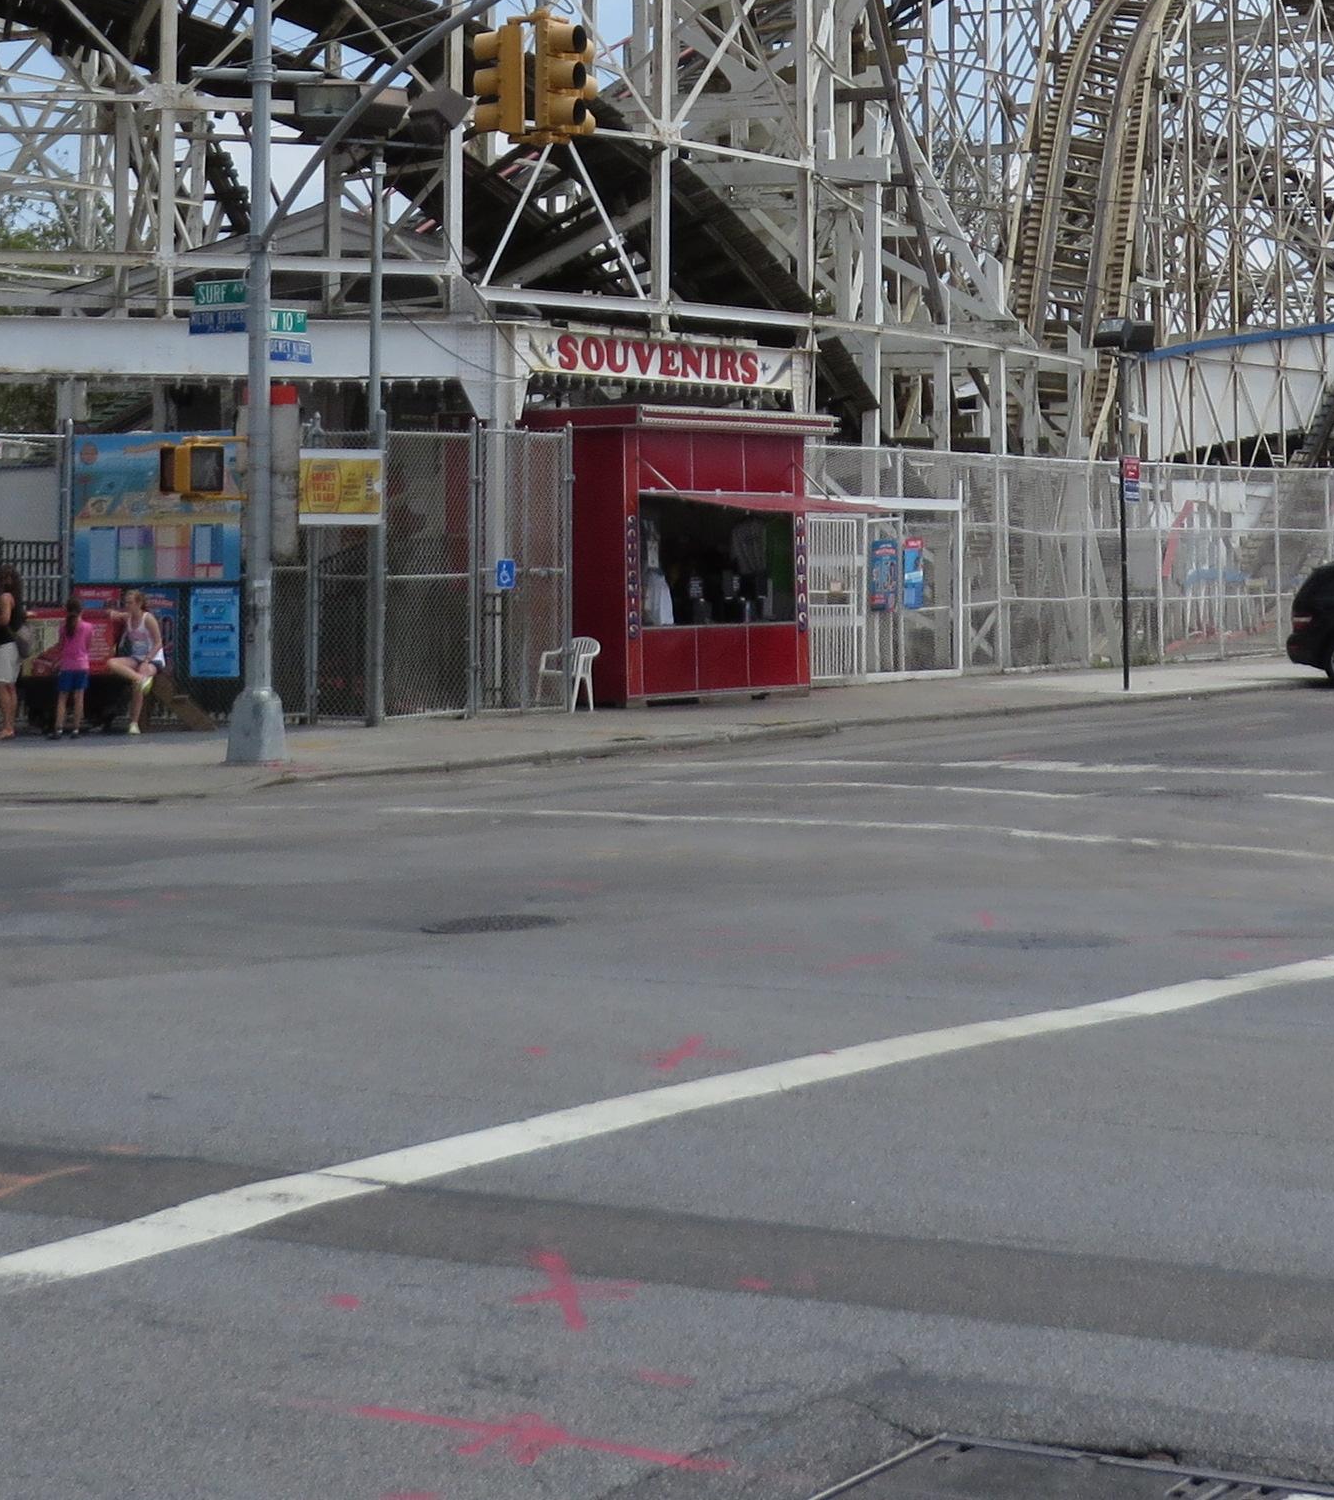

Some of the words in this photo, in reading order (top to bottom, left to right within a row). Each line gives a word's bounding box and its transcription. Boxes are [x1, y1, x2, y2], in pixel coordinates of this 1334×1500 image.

[198, 284, 227, 304] SURF
[270, 312, 279, 330] W
[282, 312, 294, 331] 10
[556, 335, 759, 385] SOUVENIRS
[796, 515, 807, 631] PHOTOS
